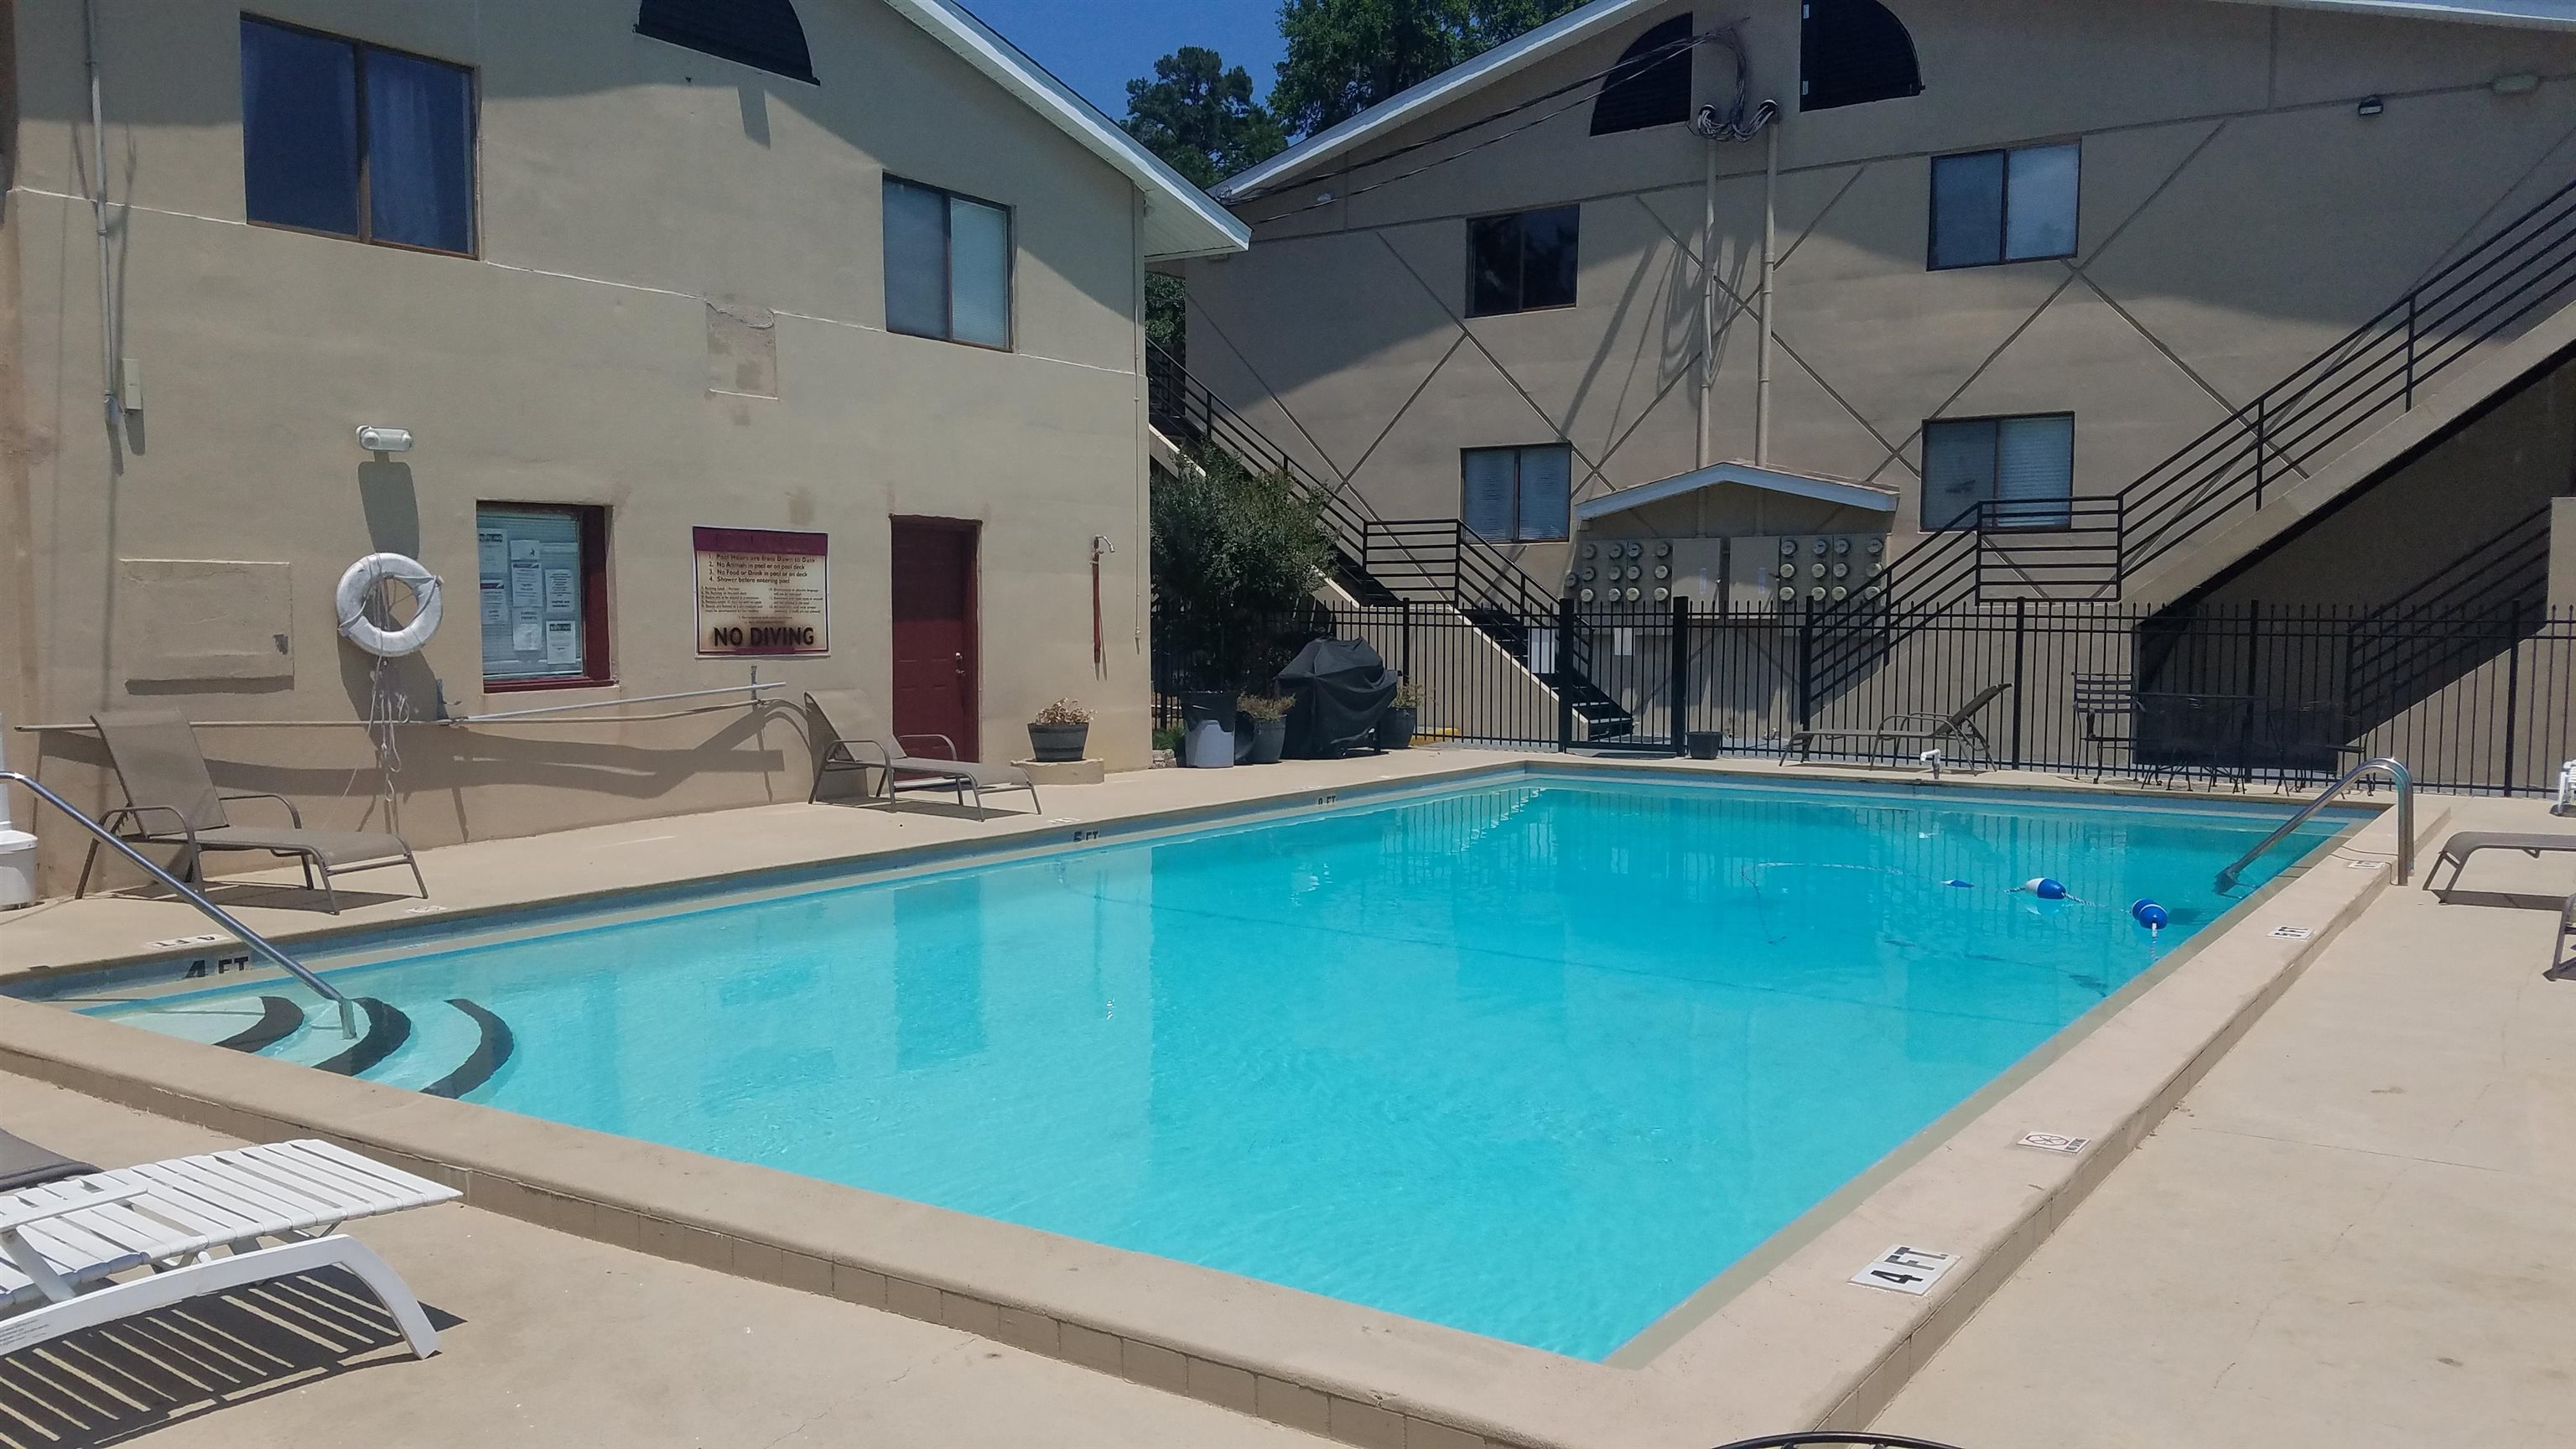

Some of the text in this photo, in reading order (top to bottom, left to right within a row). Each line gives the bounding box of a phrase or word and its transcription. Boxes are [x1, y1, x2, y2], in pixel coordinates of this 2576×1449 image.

[714, 627, 814, 647] NO DIVING
[1085, 831, 1098, 840] FT
[181, 956, 249, 980] 4 FT
[1870, 1270, 1924, 1285] 4
